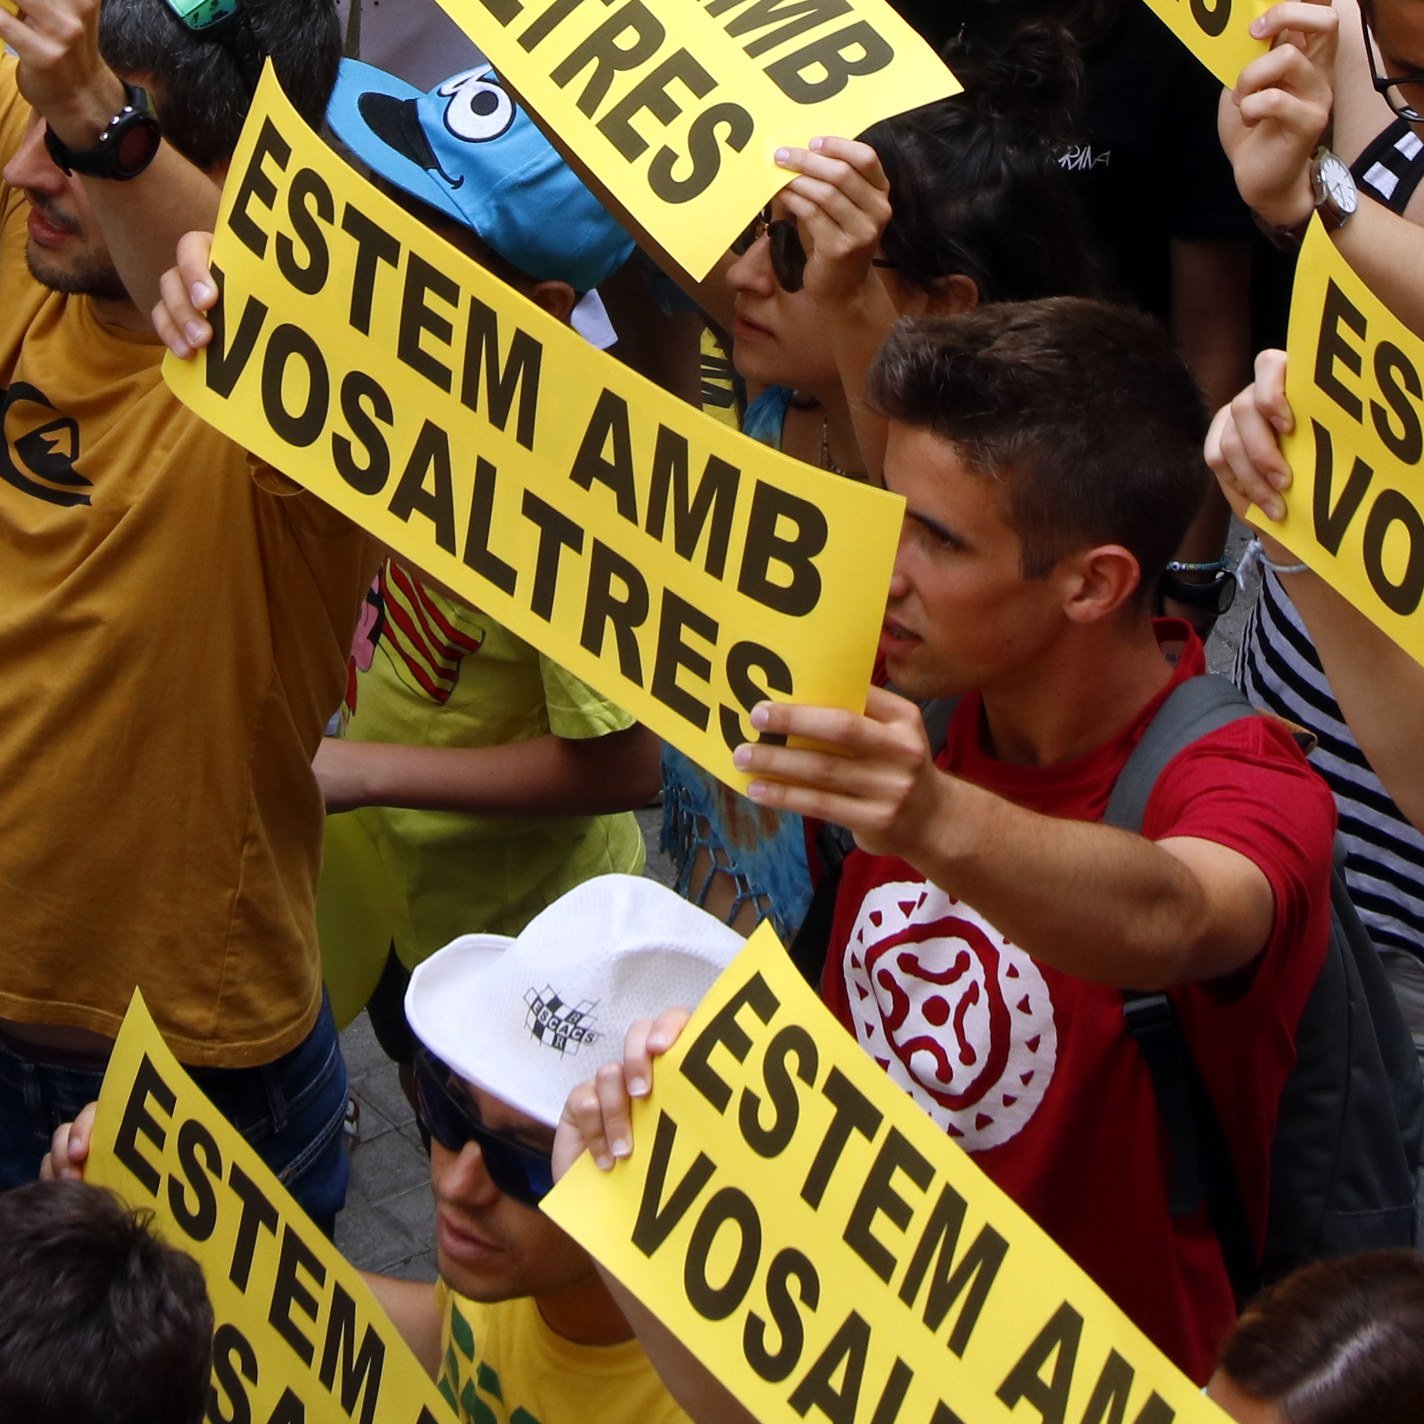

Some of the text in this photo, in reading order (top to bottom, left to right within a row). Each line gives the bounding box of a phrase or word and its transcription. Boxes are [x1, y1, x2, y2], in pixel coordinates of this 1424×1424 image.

[202, 264, 795, 773] VOSALTRES
[227, 116, 831, 620] ESTEM AMB
[112, 1050, 386, 1421] ESTEM
[678, 970, 1010, 1361] ESTEM
